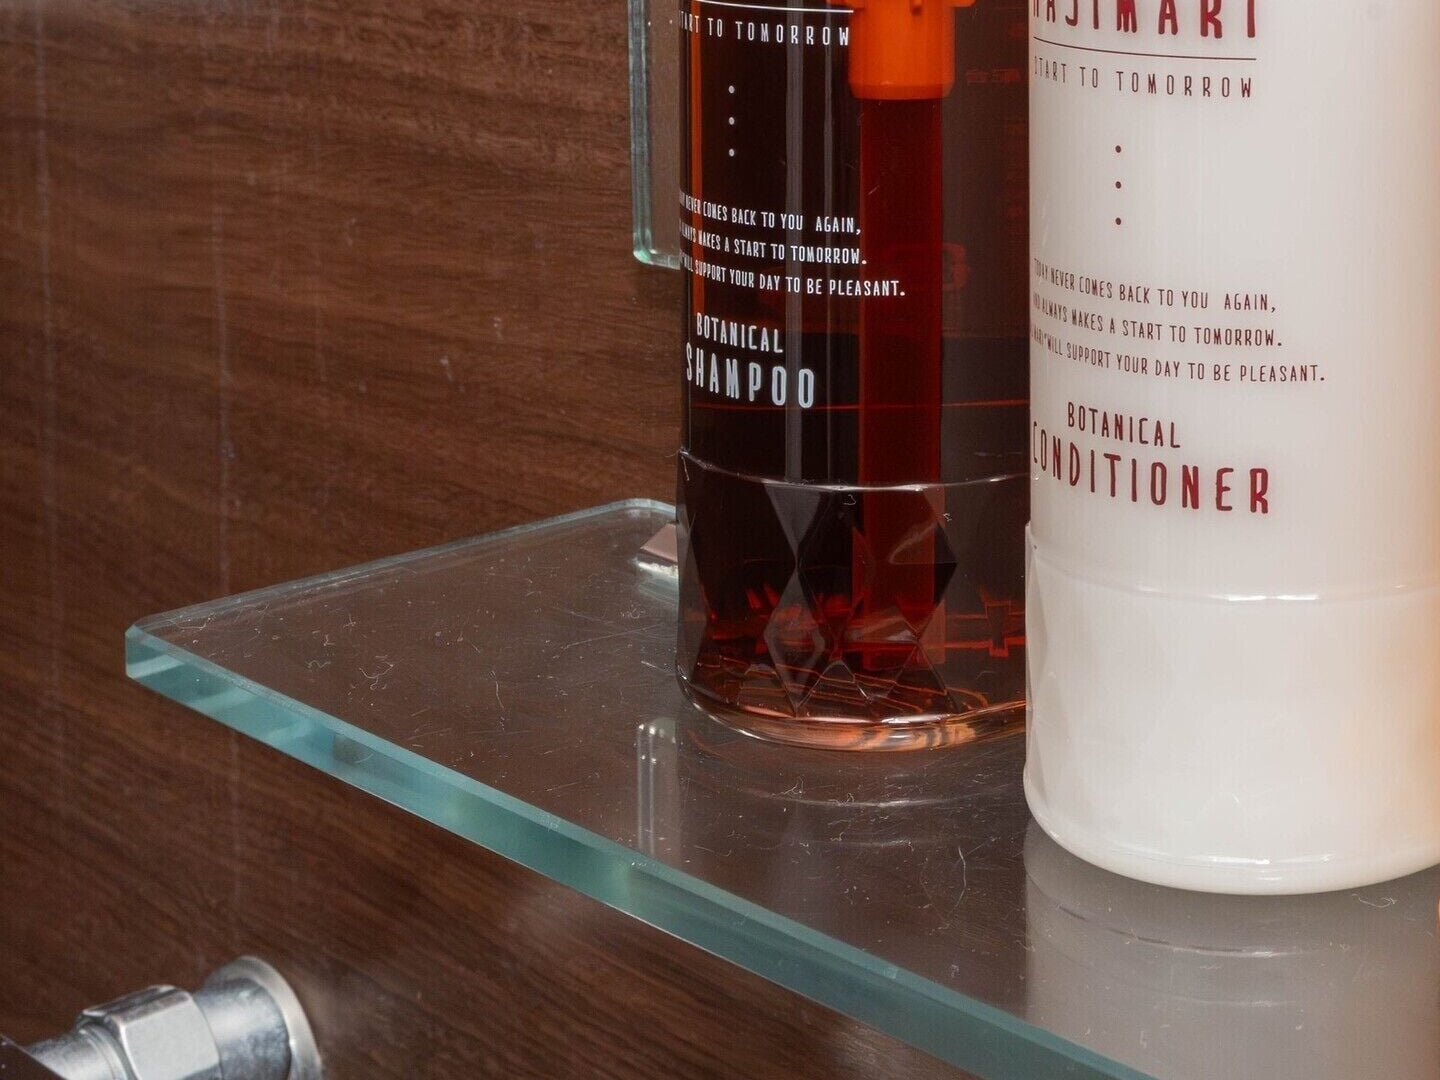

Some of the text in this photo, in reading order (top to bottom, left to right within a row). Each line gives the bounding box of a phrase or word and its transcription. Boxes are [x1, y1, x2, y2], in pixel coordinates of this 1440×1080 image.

[708, 17, 723, 37] TO
[735, 21, 849, 46] TOMORROW
[1080, 66, 1099, 88] TO
[1116, 71, 1252, 99] TOMORROW
[703, 201, 728, 221] COMES
[731, 207, 757, 226] BACK
[761, 211, 776, 228] TO
[780, 214, 804, 230] YOU
[815, 216, 862, 236] AGAIN,
[698, 229, 721, 251] MAKES
[725, 236, 730, 253] A
[734, 238, 766, 258] START
[770, 244, 785, 260] TO
[790, 245, 868, 265] TOMORROW.
[695, 259, 726, 283] SUPPORT
[730, 269, 754, 288] YOUR
[759, 273, 780, 291] DAY
[785, 276, 800, 293] TO
[807, 278, 822, 295] BE
[829, 280, 906, 297] PLEASANT.
[1051, 267, 1075, 291] NEVER
[1080, 276, 1113, 299] COMES
[1119, 284, 1151, 304] BACK
[1158, 289, 1174, 307] TO
[1182, 291, 1208, 309] YOU
[1224, 293, 1276, 313] AGAIN,
[697, 312, 784, 354] BOTANICAL
[1042, 298, 1068, 323] ALWAYS
[1072, 308, 1104, 332] MAKES
[1110, 318, 1116, 334] A
[1122, 319, 1162, 342] START
[1169, 325, 1186, 343] TO
[1194, 327, 1283, 347] TOMORROW.
[686, 342, 815, 409] SHAMPOO
[1066, 342, 1111, 369] SUPPORT
[1117, 353, 1148, 375] YOUR
[1156, 360, 1180, 377] DAY
[1188, 363, 1205, 380] TO
[1213, 365, 1231, 381] BE
[1240, 365, 1326, 381] PLEASANT.
[1068, 402, 1181, 448] BOTANICAL
[1033, 421, 1269, 514] CONDITIONER
